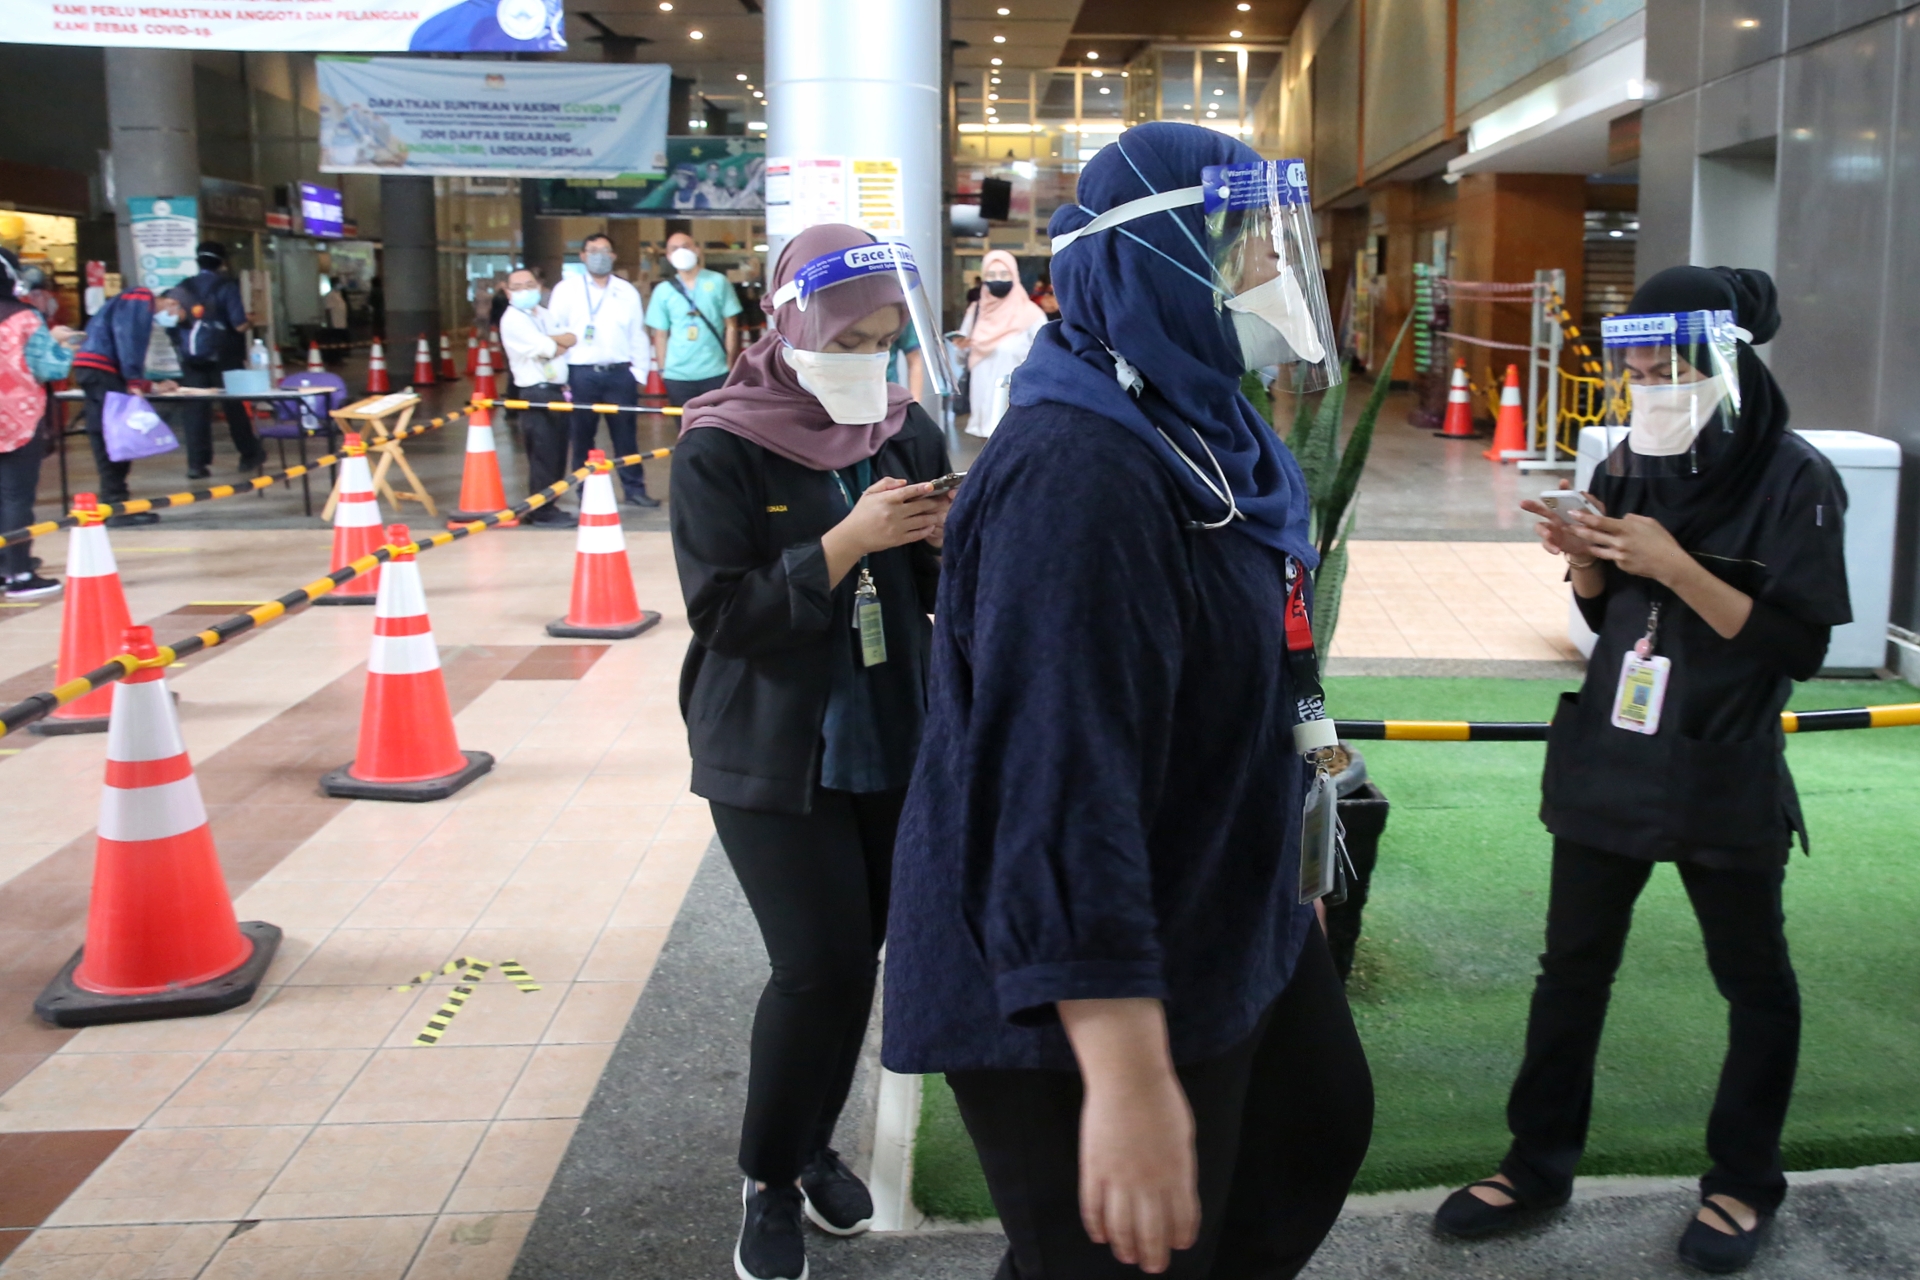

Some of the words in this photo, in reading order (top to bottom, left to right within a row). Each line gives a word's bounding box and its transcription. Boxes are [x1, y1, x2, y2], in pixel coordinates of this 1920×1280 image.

[53, 5, 87, 15] KAMI
[91, 6, 135, 17] PERLU
[139, 7, 231, 20] MEMASTIKAN
[236, 10, 302, 21] ANGGOTA
[306, 11, 332, 21] DAN
[337, 11, 419, 21] PELANGGAN
[54, 21, 88, 31] KAMI
[94, 22, 138, 33] BEBAS
[368, 97, 440, 109] DAPATKAN
[443, 100, 510, 111] SUNTIKAN
[512, 102, 560, 113] VAKSIN
[421, 130, 446, 140] JOM
[449, 130, 500, 141] DAFTAR
[503, 131, 571, 143] SEKARANG
[491, 146, 548, 157] LINDUNG
[551, 147, 592, 157] SEMUA
[851, 250, 885, 265] Face
[1623, 321, 1665, 332] shield
